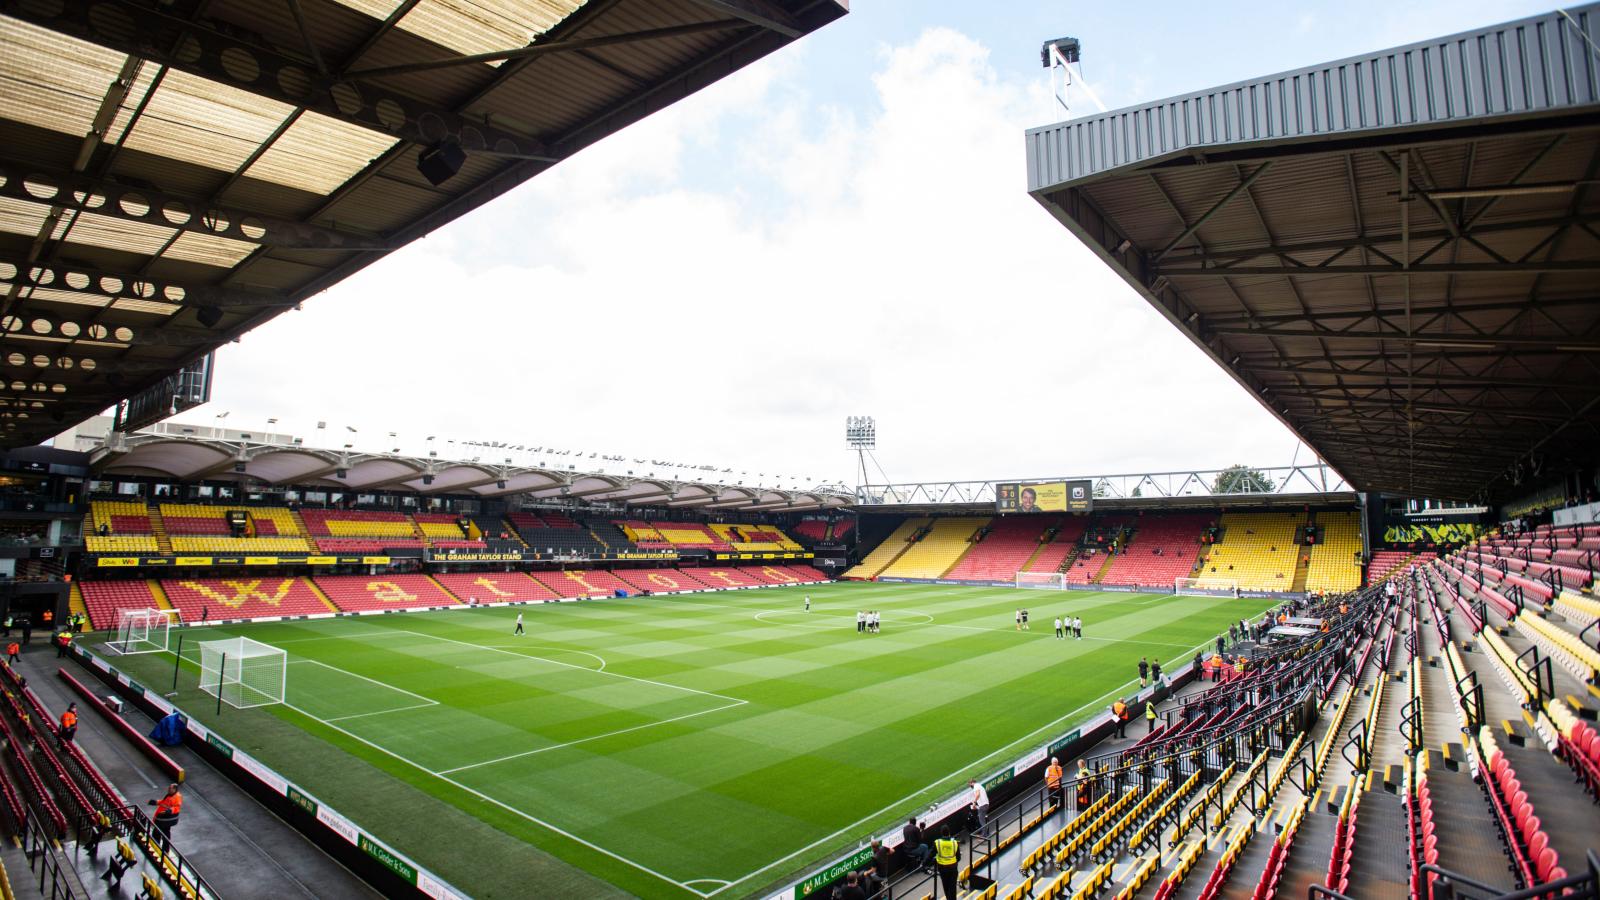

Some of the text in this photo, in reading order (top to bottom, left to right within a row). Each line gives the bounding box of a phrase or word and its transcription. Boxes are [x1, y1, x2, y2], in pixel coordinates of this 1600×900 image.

[830, 860, 853, 878] Ginder
[853, 857, 859, 866] &
[859, 850, 875, 863] Sons
